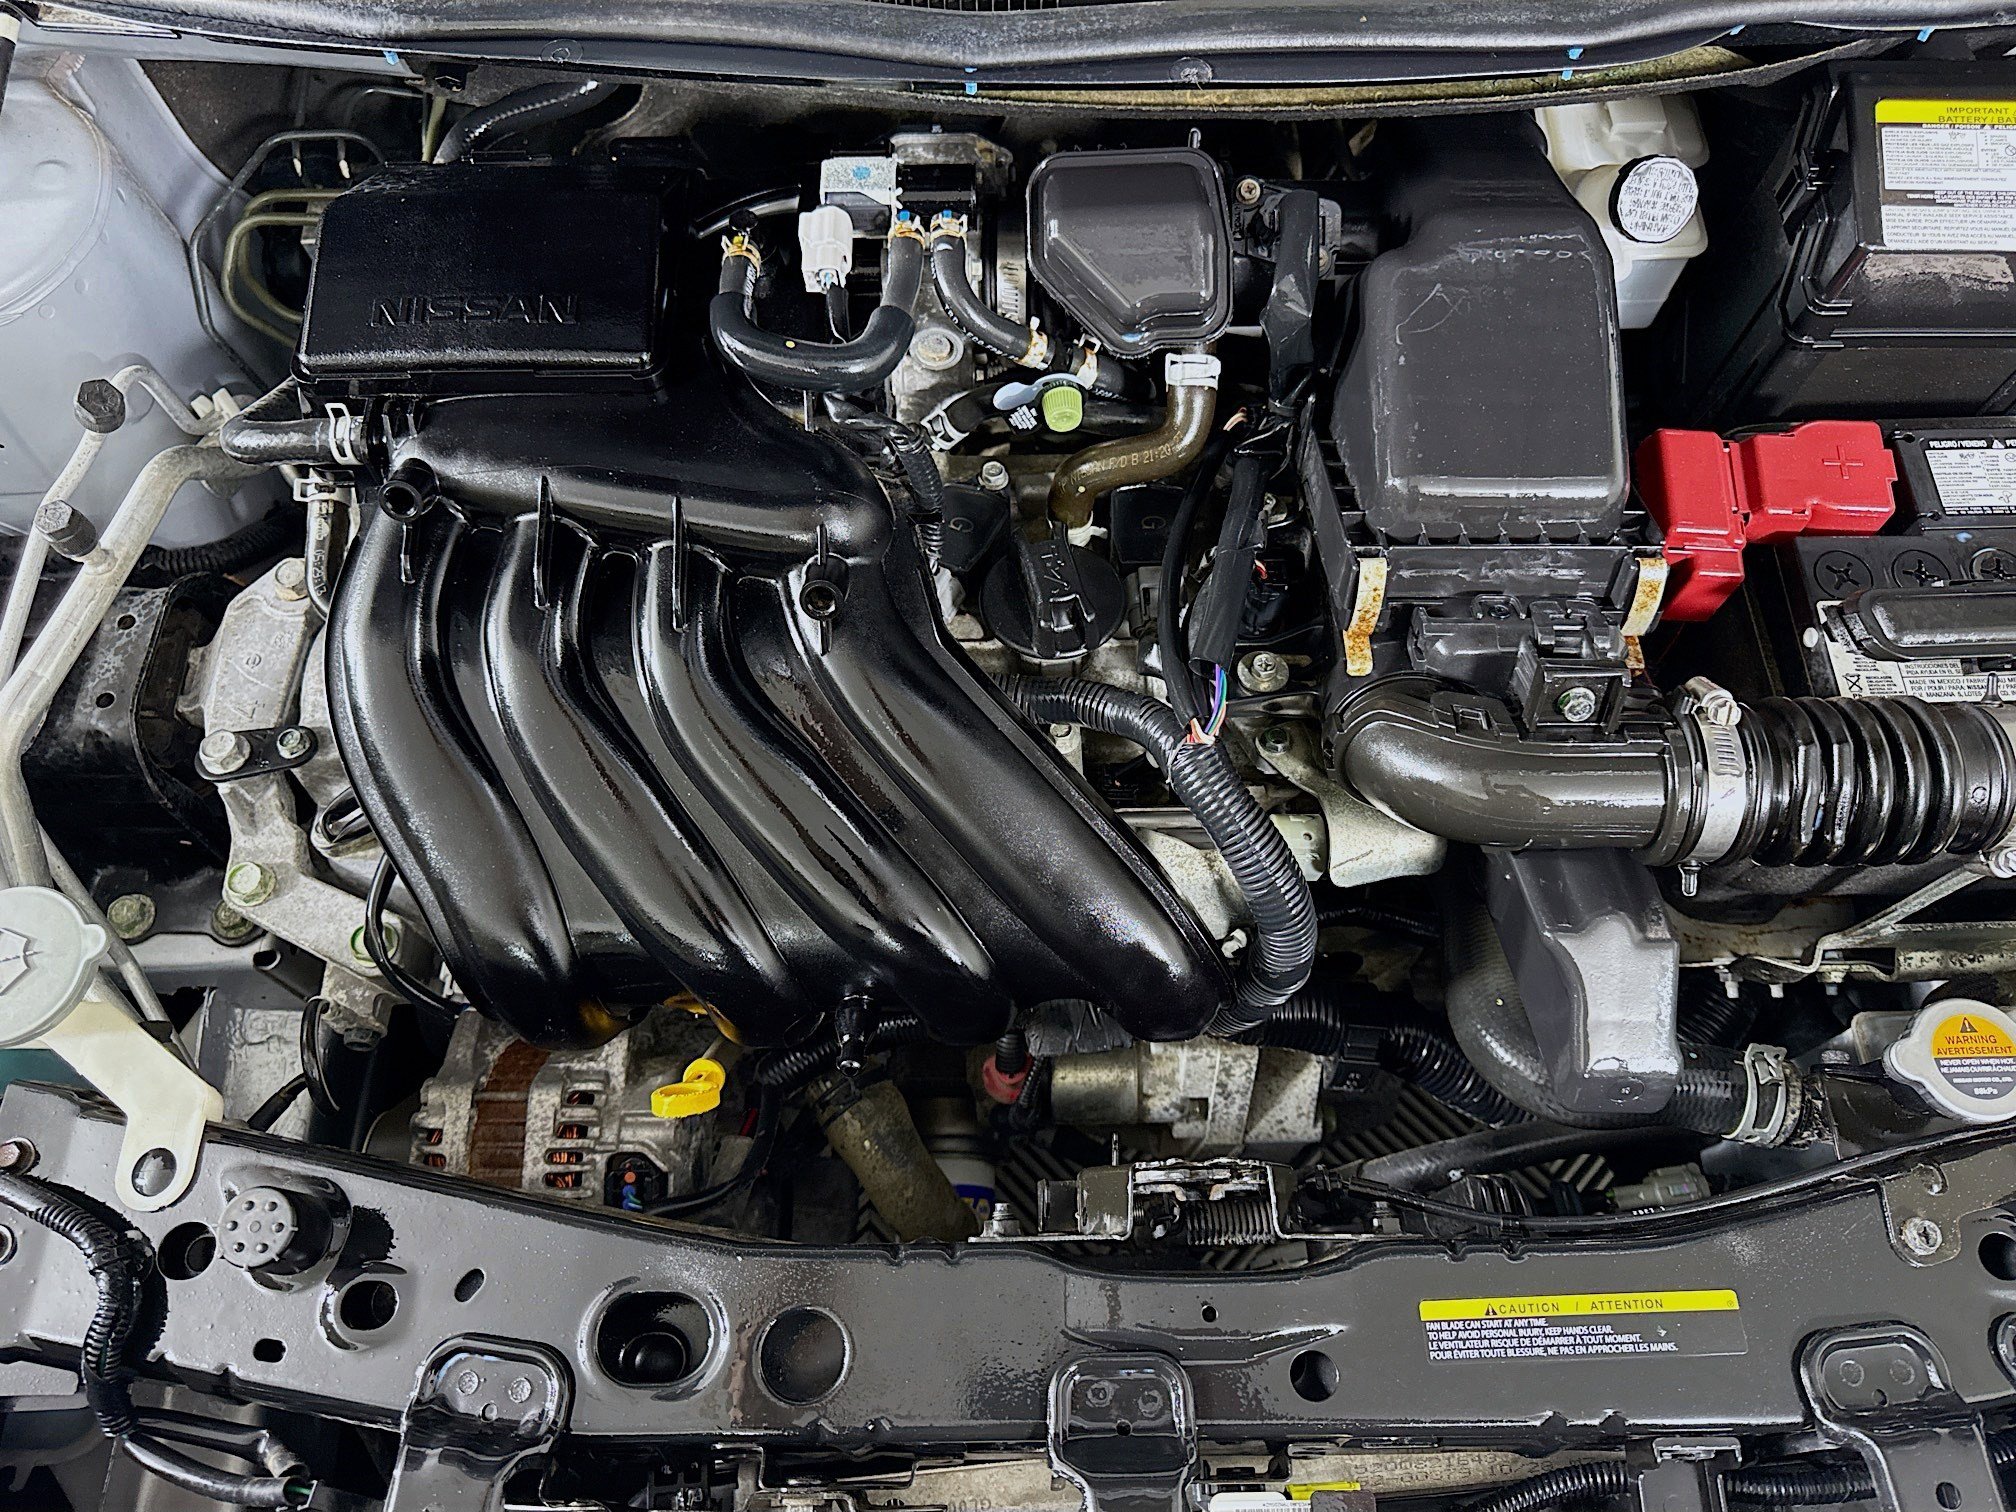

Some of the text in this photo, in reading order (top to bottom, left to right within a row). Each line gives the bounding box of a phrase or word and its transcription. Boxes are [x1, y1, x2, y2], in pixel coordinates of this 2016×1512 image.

[1946, 106, 2009, 115] IMPORTANT
[1938, 115, 1988, 123] BATTERY
[369, 294, 579, 328] NISSAN
[1944, 1035, 1997, 1044] WARNING
[1937, 1046, 2012, 1055] AVERTISSEMENT
[1499, 1302, 1560, 1315] CAUTION
[1590, 1299, 1664, 1311] ATTENTION
[1426, 1317, 1548, 1331] FAN BLADE CAN START AT ANY TIME.
[1427, 1332, 1438, 1340] TO
[1439, 1331, 1457, 1340] HELP
[1458, 1330, 1480, 1339] AVOID
[1481, 1329, 1518, 1338] PERSONAL
[1544, 1326, 1562, 1336] KEEP
[1563, 1326, 1588, 1335] HANDS
[1588, 1325, 1614, 1334] CLEAR.
[1429, 1333, 1643, 1350] LE VENTILATEUR RISQUE DE DÉMARRER À TOUT MOMENT.
[1430, 1341, 1679, 1360] POUR ÉVITER TOUTE BLESSURE, NE PAS EN APPROCHER LES MAINS.
